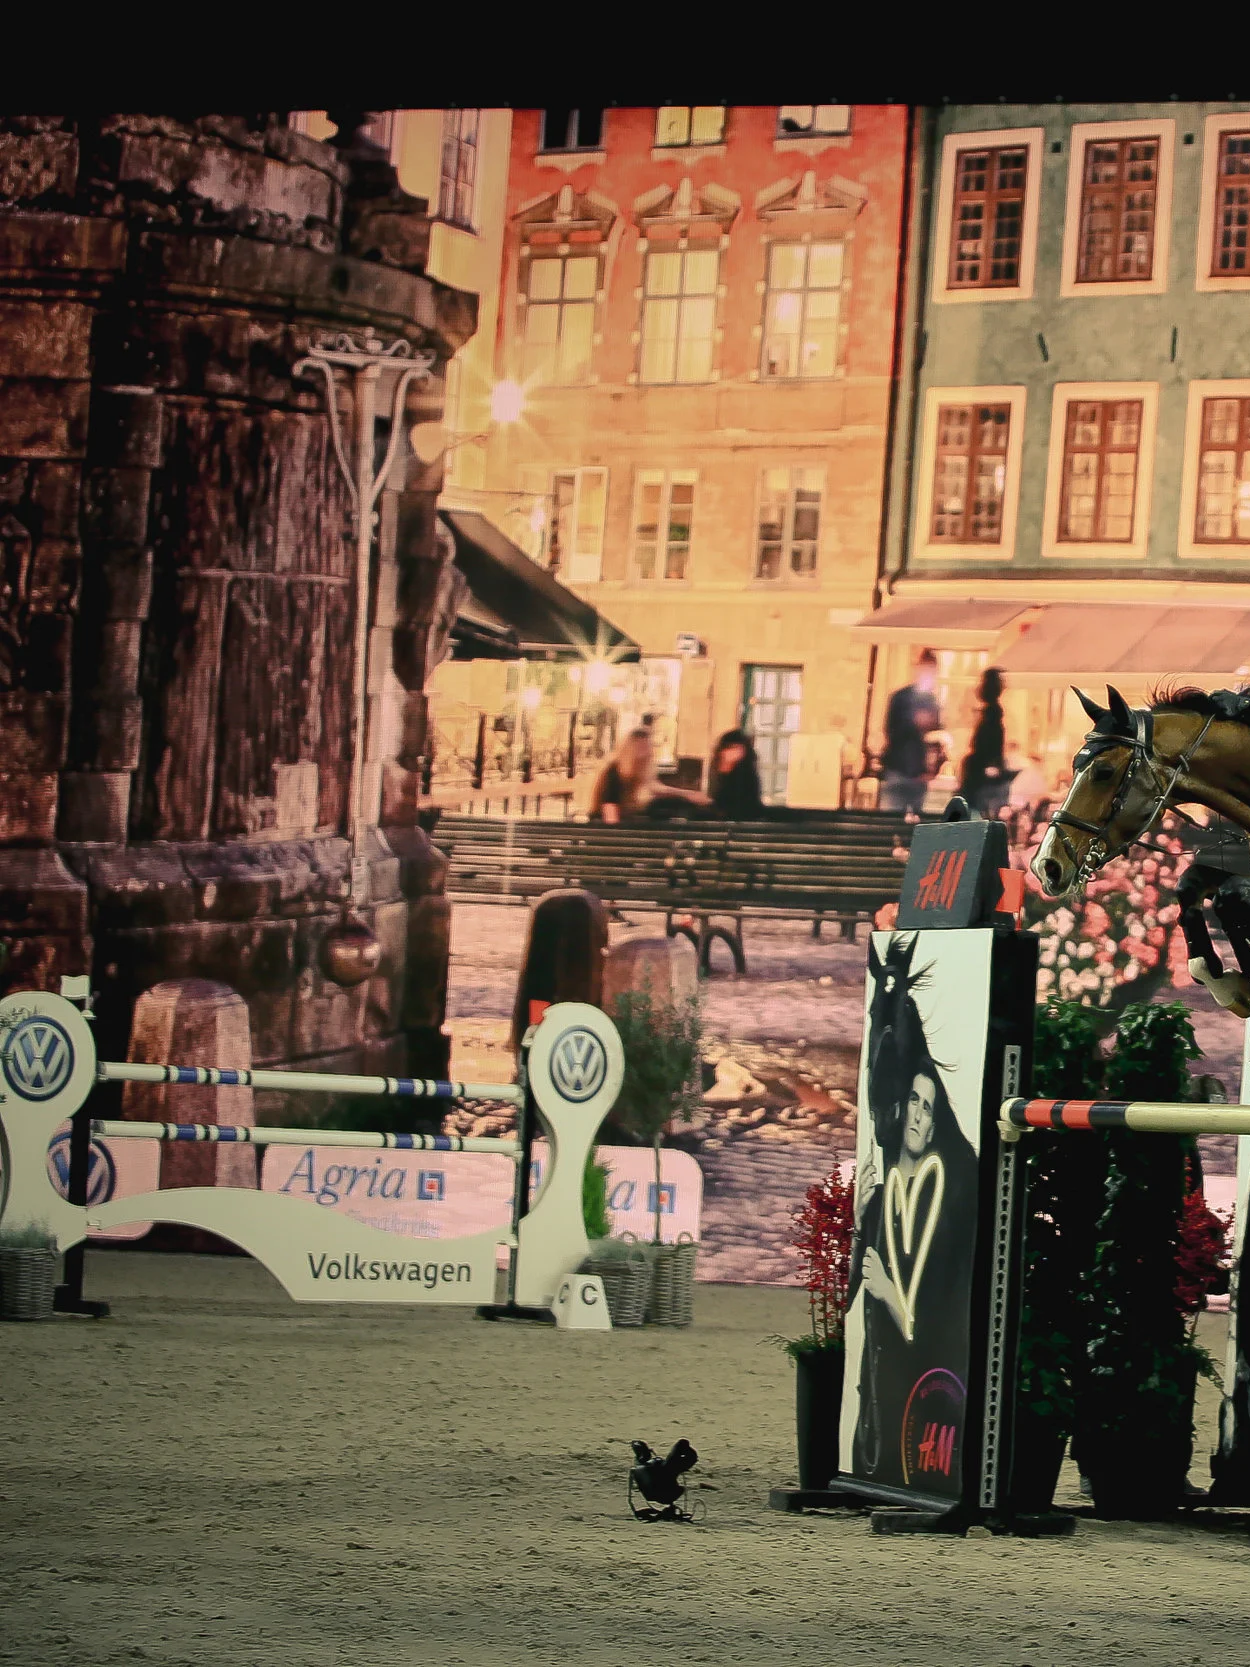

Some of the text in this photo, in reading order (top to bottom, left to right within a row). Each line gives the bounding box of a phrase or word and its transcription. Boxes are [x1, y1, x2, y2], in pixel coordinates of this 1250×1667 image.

[913, 850, 968, 910] H&M
[279, 1147, 408, 1206] Agria
[307, 1252, 472, 1289] Volkswagen
